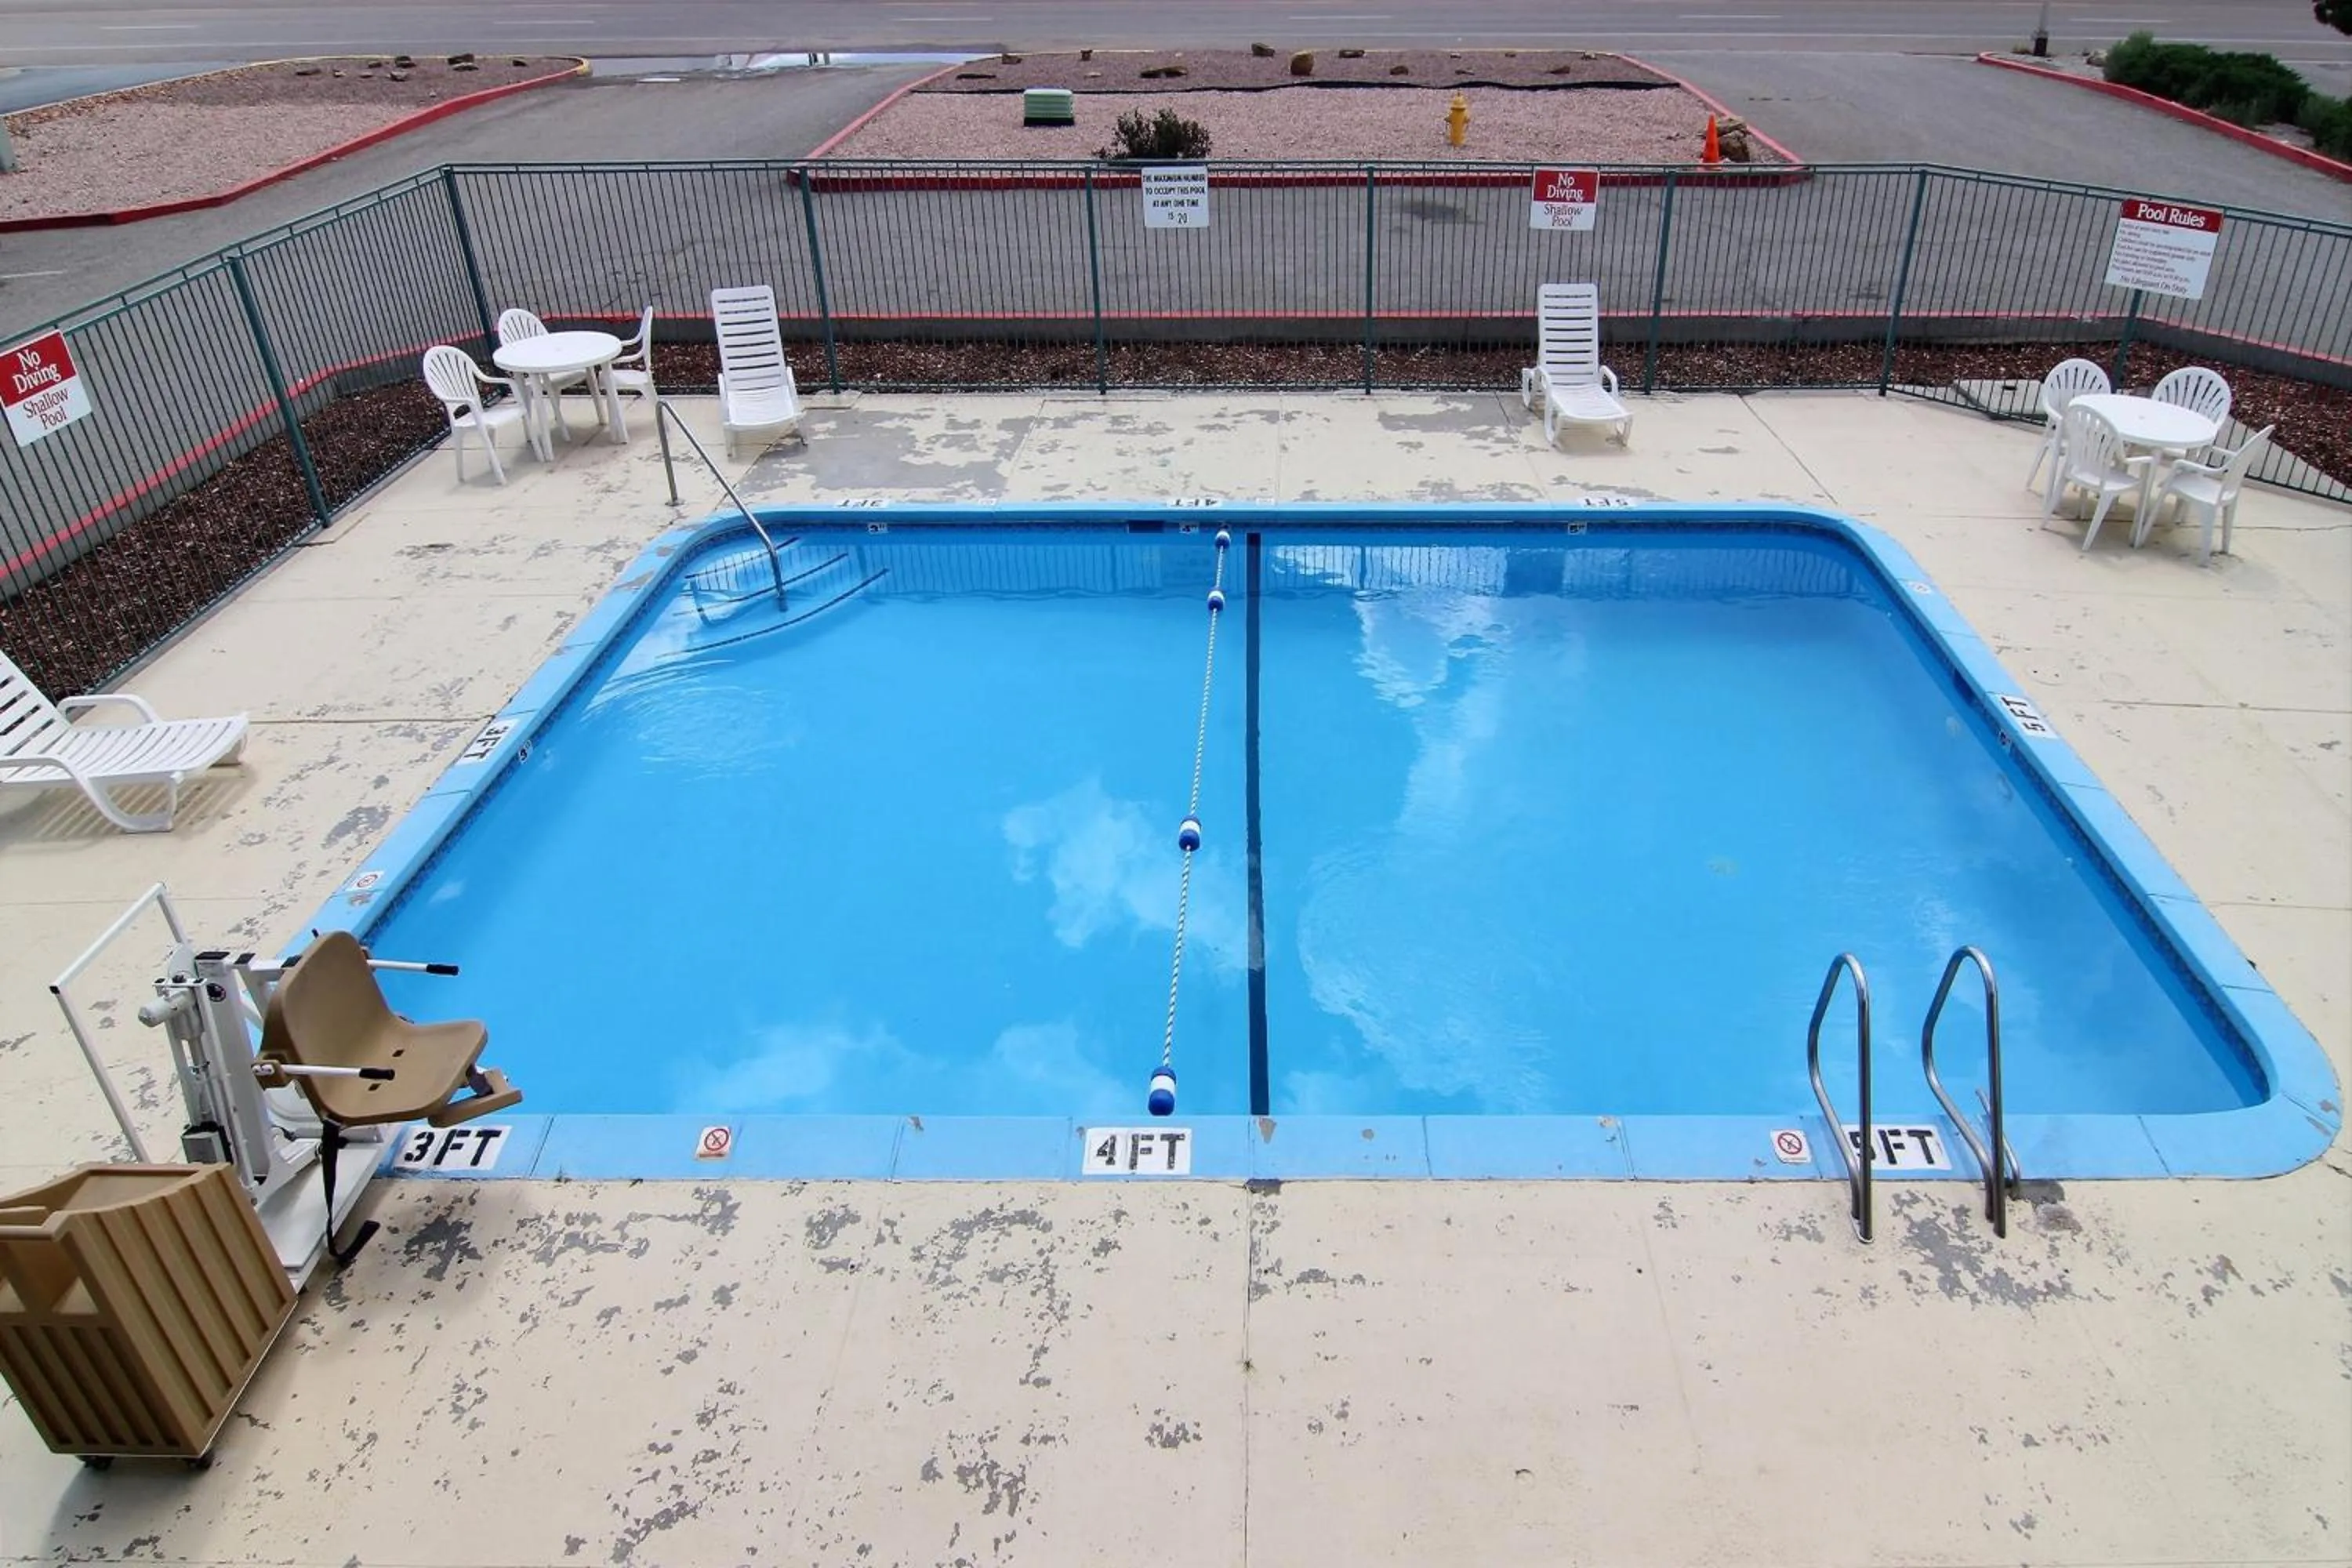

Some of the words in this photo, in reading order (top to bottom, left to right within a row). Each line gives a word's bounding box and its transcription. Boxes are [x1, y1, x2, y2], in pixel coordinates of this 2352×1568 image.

[1558, 172, 1575, 187] No
[1546, 184, 1584, 201] Diving
[1178, 212, 1188, 223] 20
[1544, 204, 1583, 215] Shallow
[1552, 216, 1573, 226] Pool
[2136, 203, 2167, 222] Pool
[2169, 207, 2205, 227] Rules
[16, 349, 41, 372] No
[13, 363, 62, 394] Diving
[23, 387, 69, 419] Shallow
[40, 406, 67, 430] Pool
[2001, 697, 2045, 731] 5FT
[464, 726, 509, 758] 3FT
